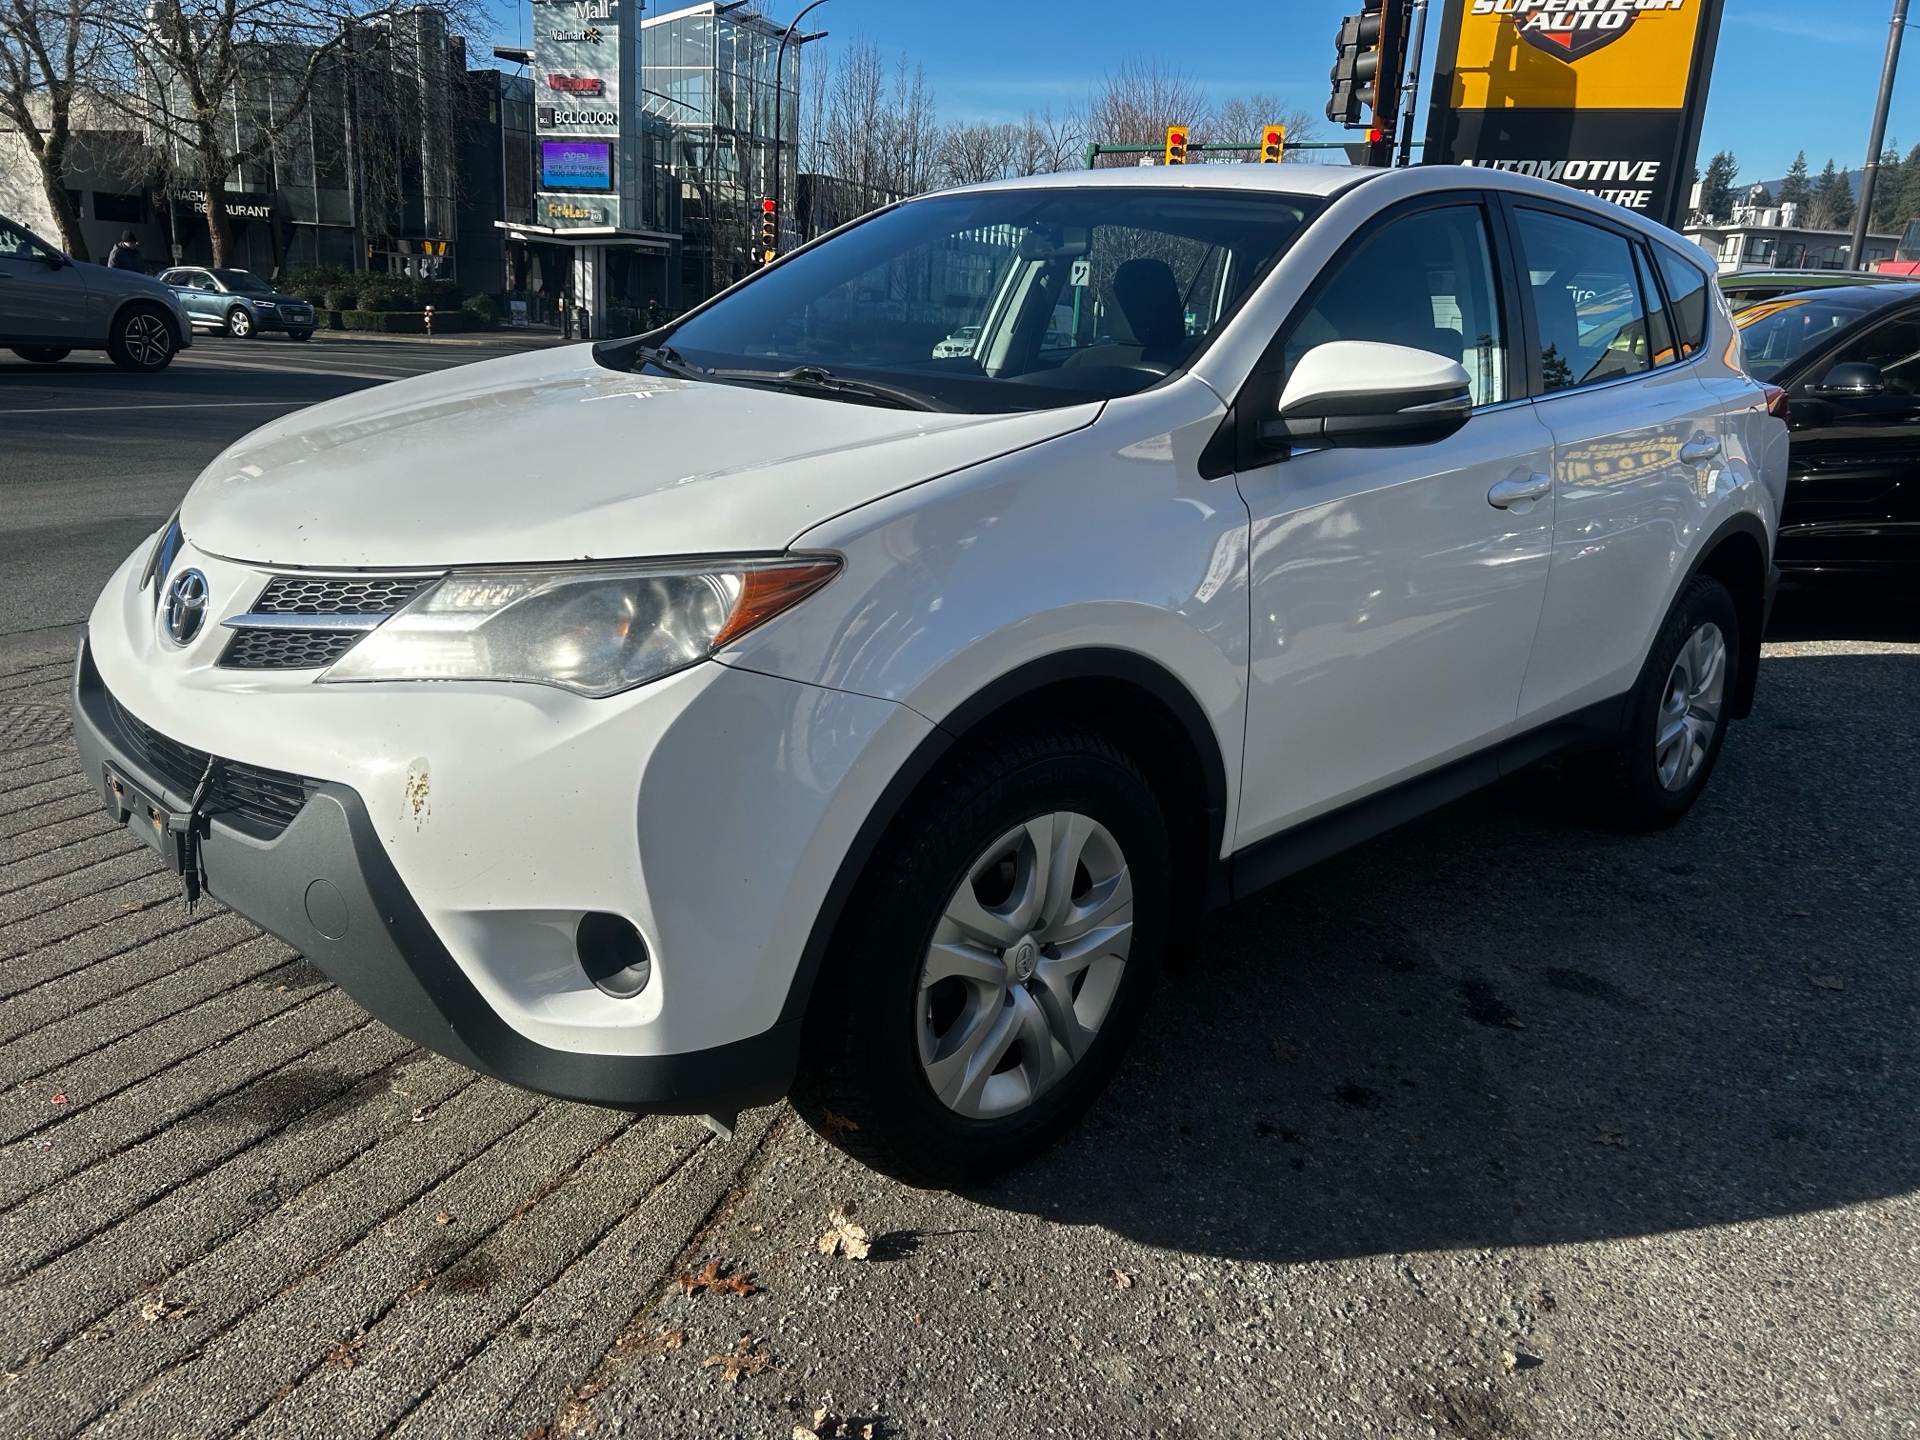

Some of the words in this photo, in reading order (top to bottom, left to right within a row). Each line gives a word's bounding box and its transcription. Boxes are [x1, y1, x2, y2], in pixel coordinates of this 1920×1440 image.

[574, 0, 609, 19] Mall
[1521, 11, 1627, 31] AUTO
[550, 30, 585, 41] Walmart
[548, 74, 600, 91] Visions
[194, 202, 271, 218] REAURANT
